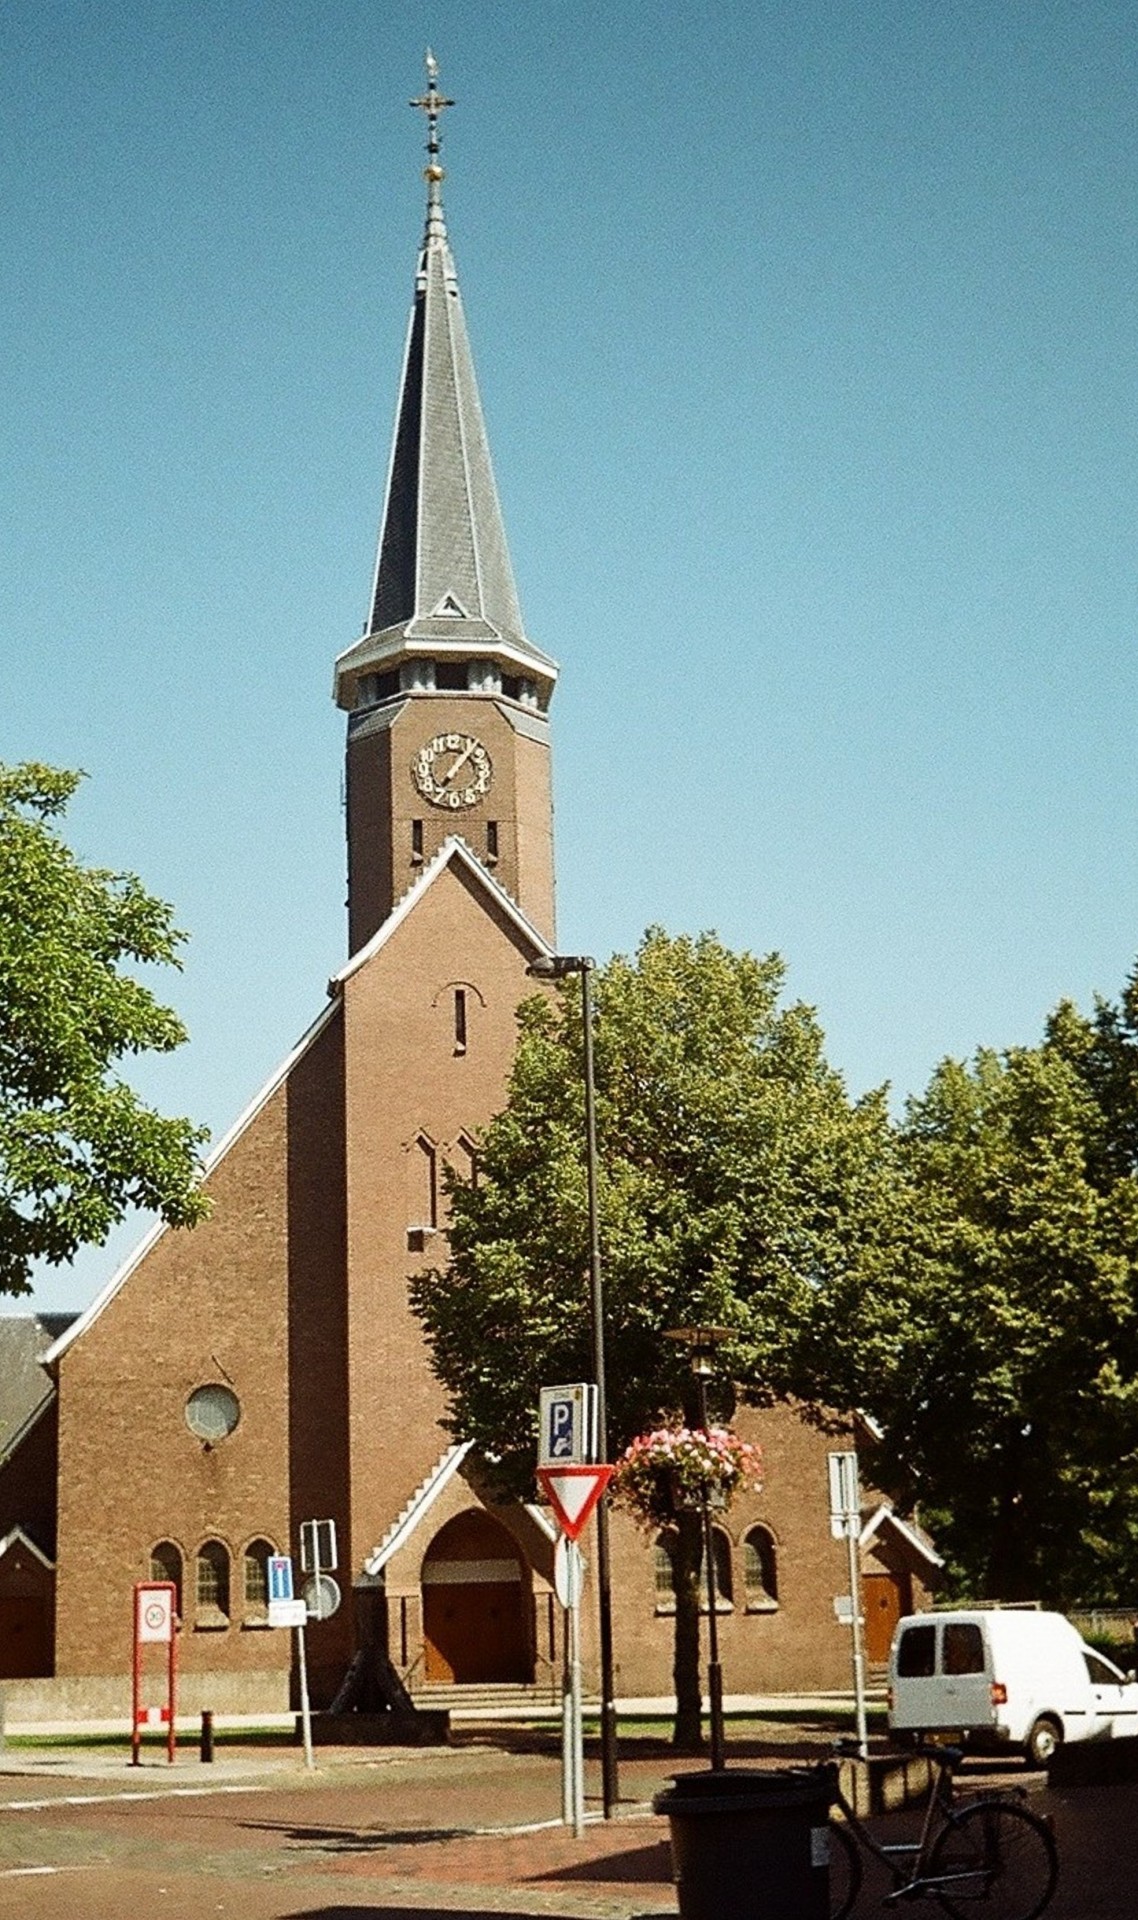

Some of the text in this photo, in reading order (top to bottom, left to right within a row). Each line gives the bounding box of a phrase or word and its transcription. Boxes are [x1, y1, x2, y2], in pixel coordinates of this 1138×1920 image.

[433, 738, 444, 752] 11
[447, 735, 459, 749] 12
[420, 749, 433, 762] 10
[475, 749, 485, 763] 2
[419, 763, 428, 777] 9
[479, 764, 489, 778] 3
[424, 777, 433, 791] 8
[475, 778, 485, 793] 4
[434, 789, 445, 803] 7
[450, 792, 459, 808] 6
[465, 789, 475, 803] 5
[554, 1405, 569, 1435] P
